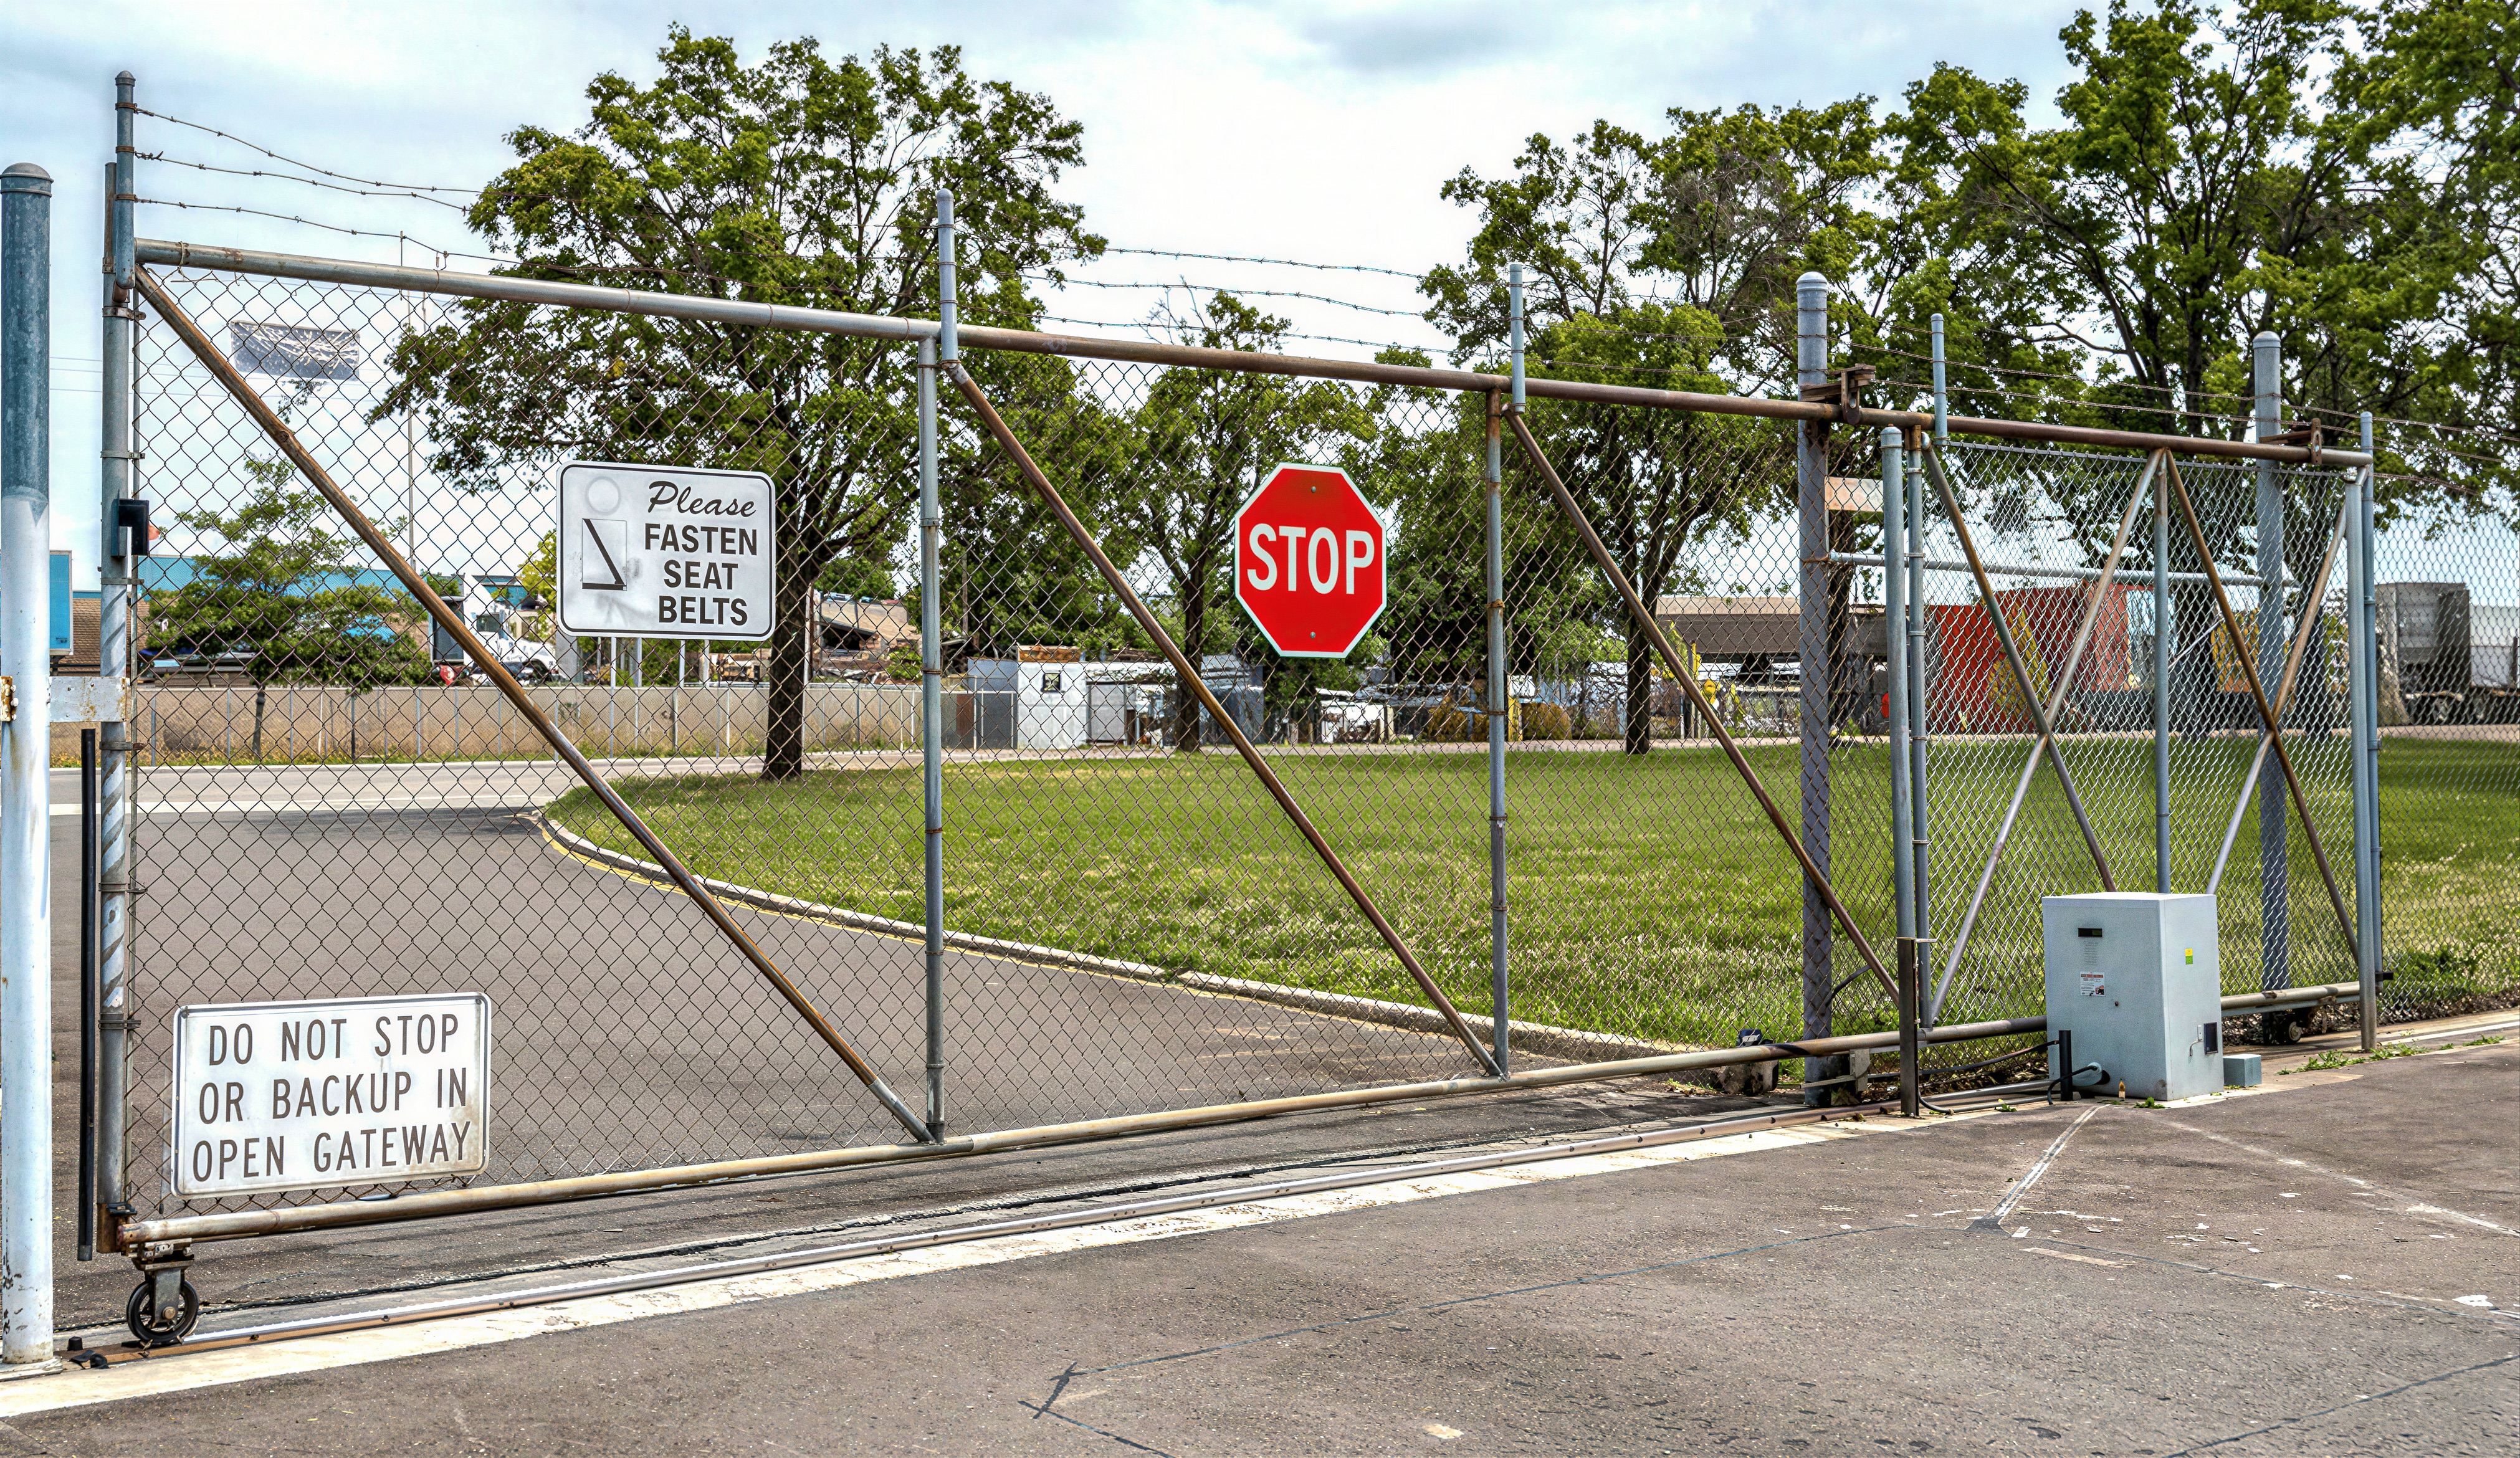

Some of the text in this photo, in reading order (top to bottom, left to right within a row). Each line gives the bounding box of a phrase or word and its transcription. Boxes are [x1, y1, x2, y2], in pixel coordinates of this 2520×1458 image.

[648, 480, 756, 517] Please
[645, 523, 757, 556] FASTEN
[1247, 523, 1375, 594] STOP
[664, 560, 738, 590] SEAT
[659, 596, 748, 626] BELTS
[209, 1014, 459, 1065] DO NOT STOP
[199, 1067, 467, 1125] OR BACKUP IN
[193, 1121, 471, 1182] OPEN GATEWAY
